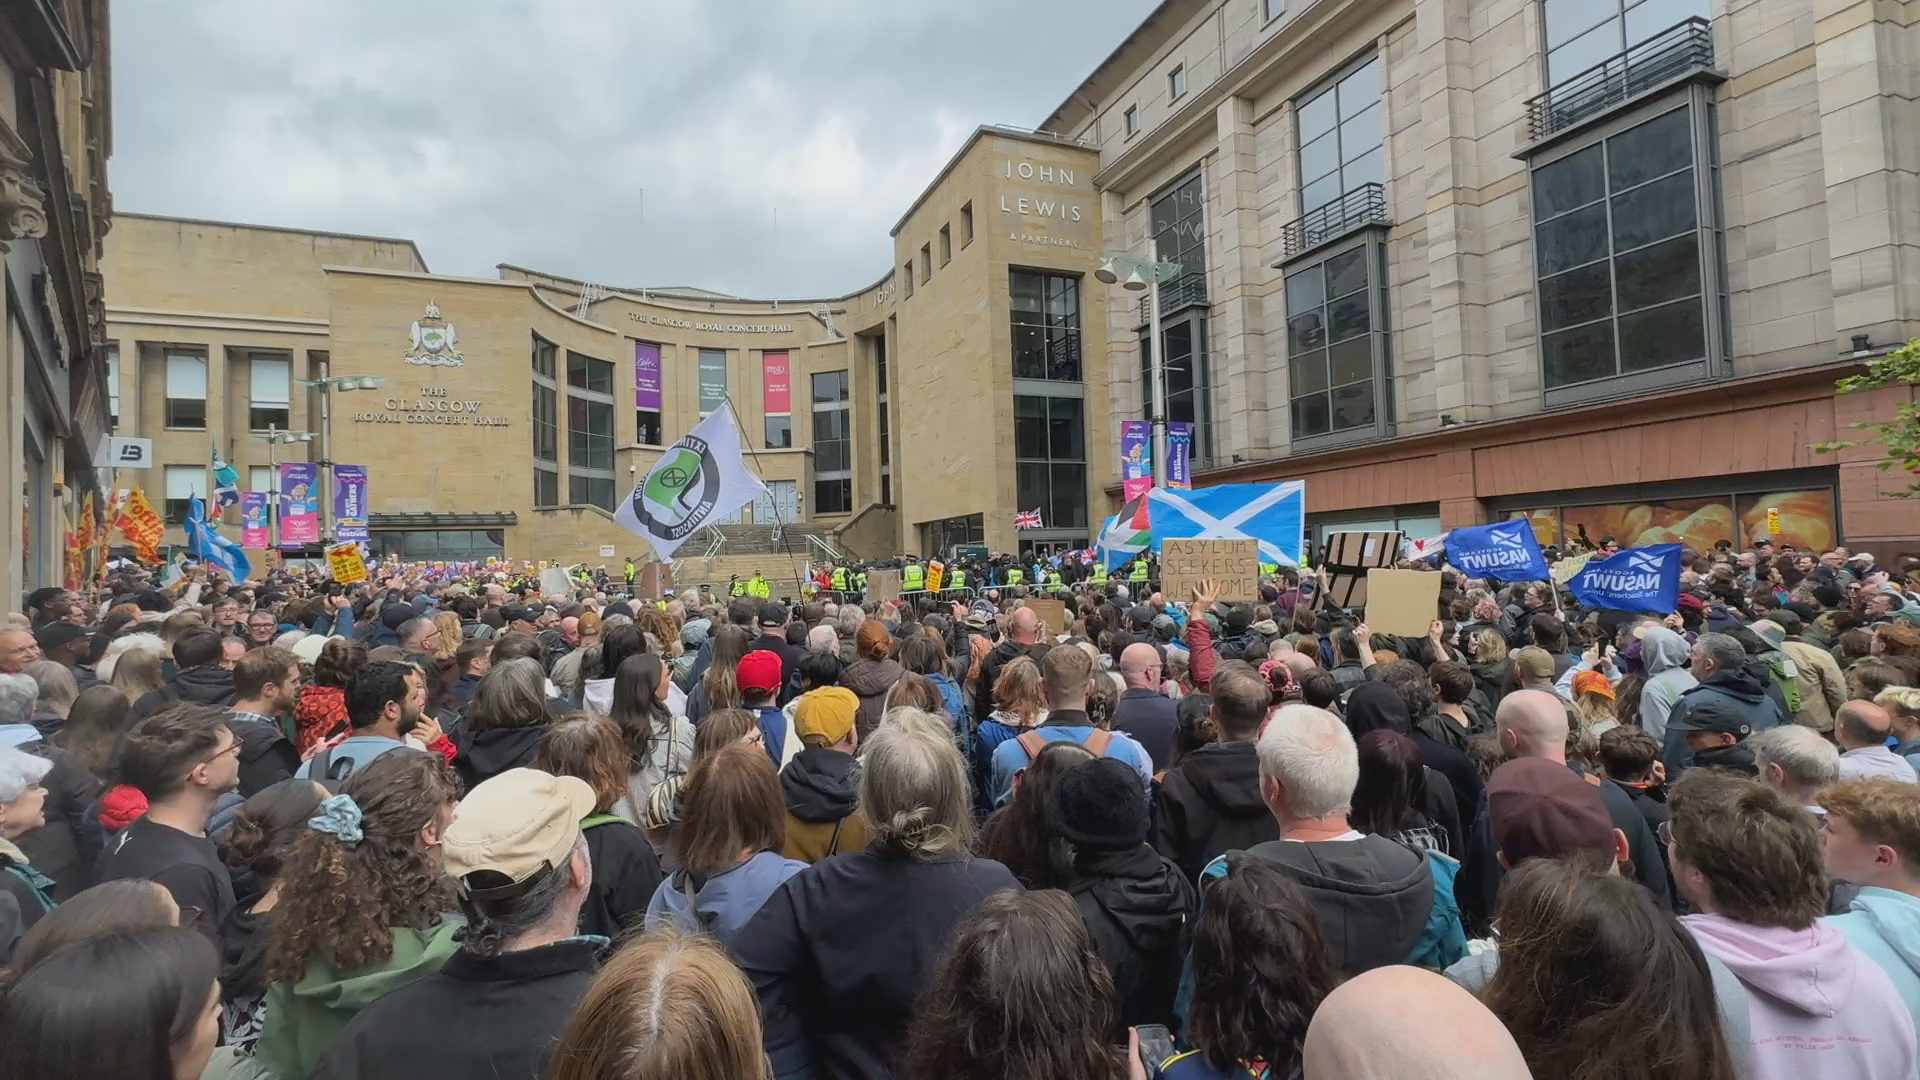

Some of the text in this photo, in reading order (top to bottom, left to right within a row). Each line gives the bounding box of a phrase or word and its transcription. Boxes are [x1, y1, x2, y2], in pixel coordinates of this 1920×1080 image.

[1005, 159, 1074, 185] JOHN
[1001, 195, 1081, 222] LEWIS
[1010, 232, 1078, 247] & PARTNERS
[872, 283, 895, 309] JOHN
[628, 312, 794, 333] THE GLASGOW ROYAL CONCERT HALL
[421, 387, 448, 397] THE
[385, 398, 481, 413] GLASGOW
[355, 412, 510, 427] ROYAL CONCERT HALL
[1169, 540, 1247, 555] ASYLUM
[1166, 559, 1247, 576] SEEKERS
[1166, 578, 1253, 599] WEOME
